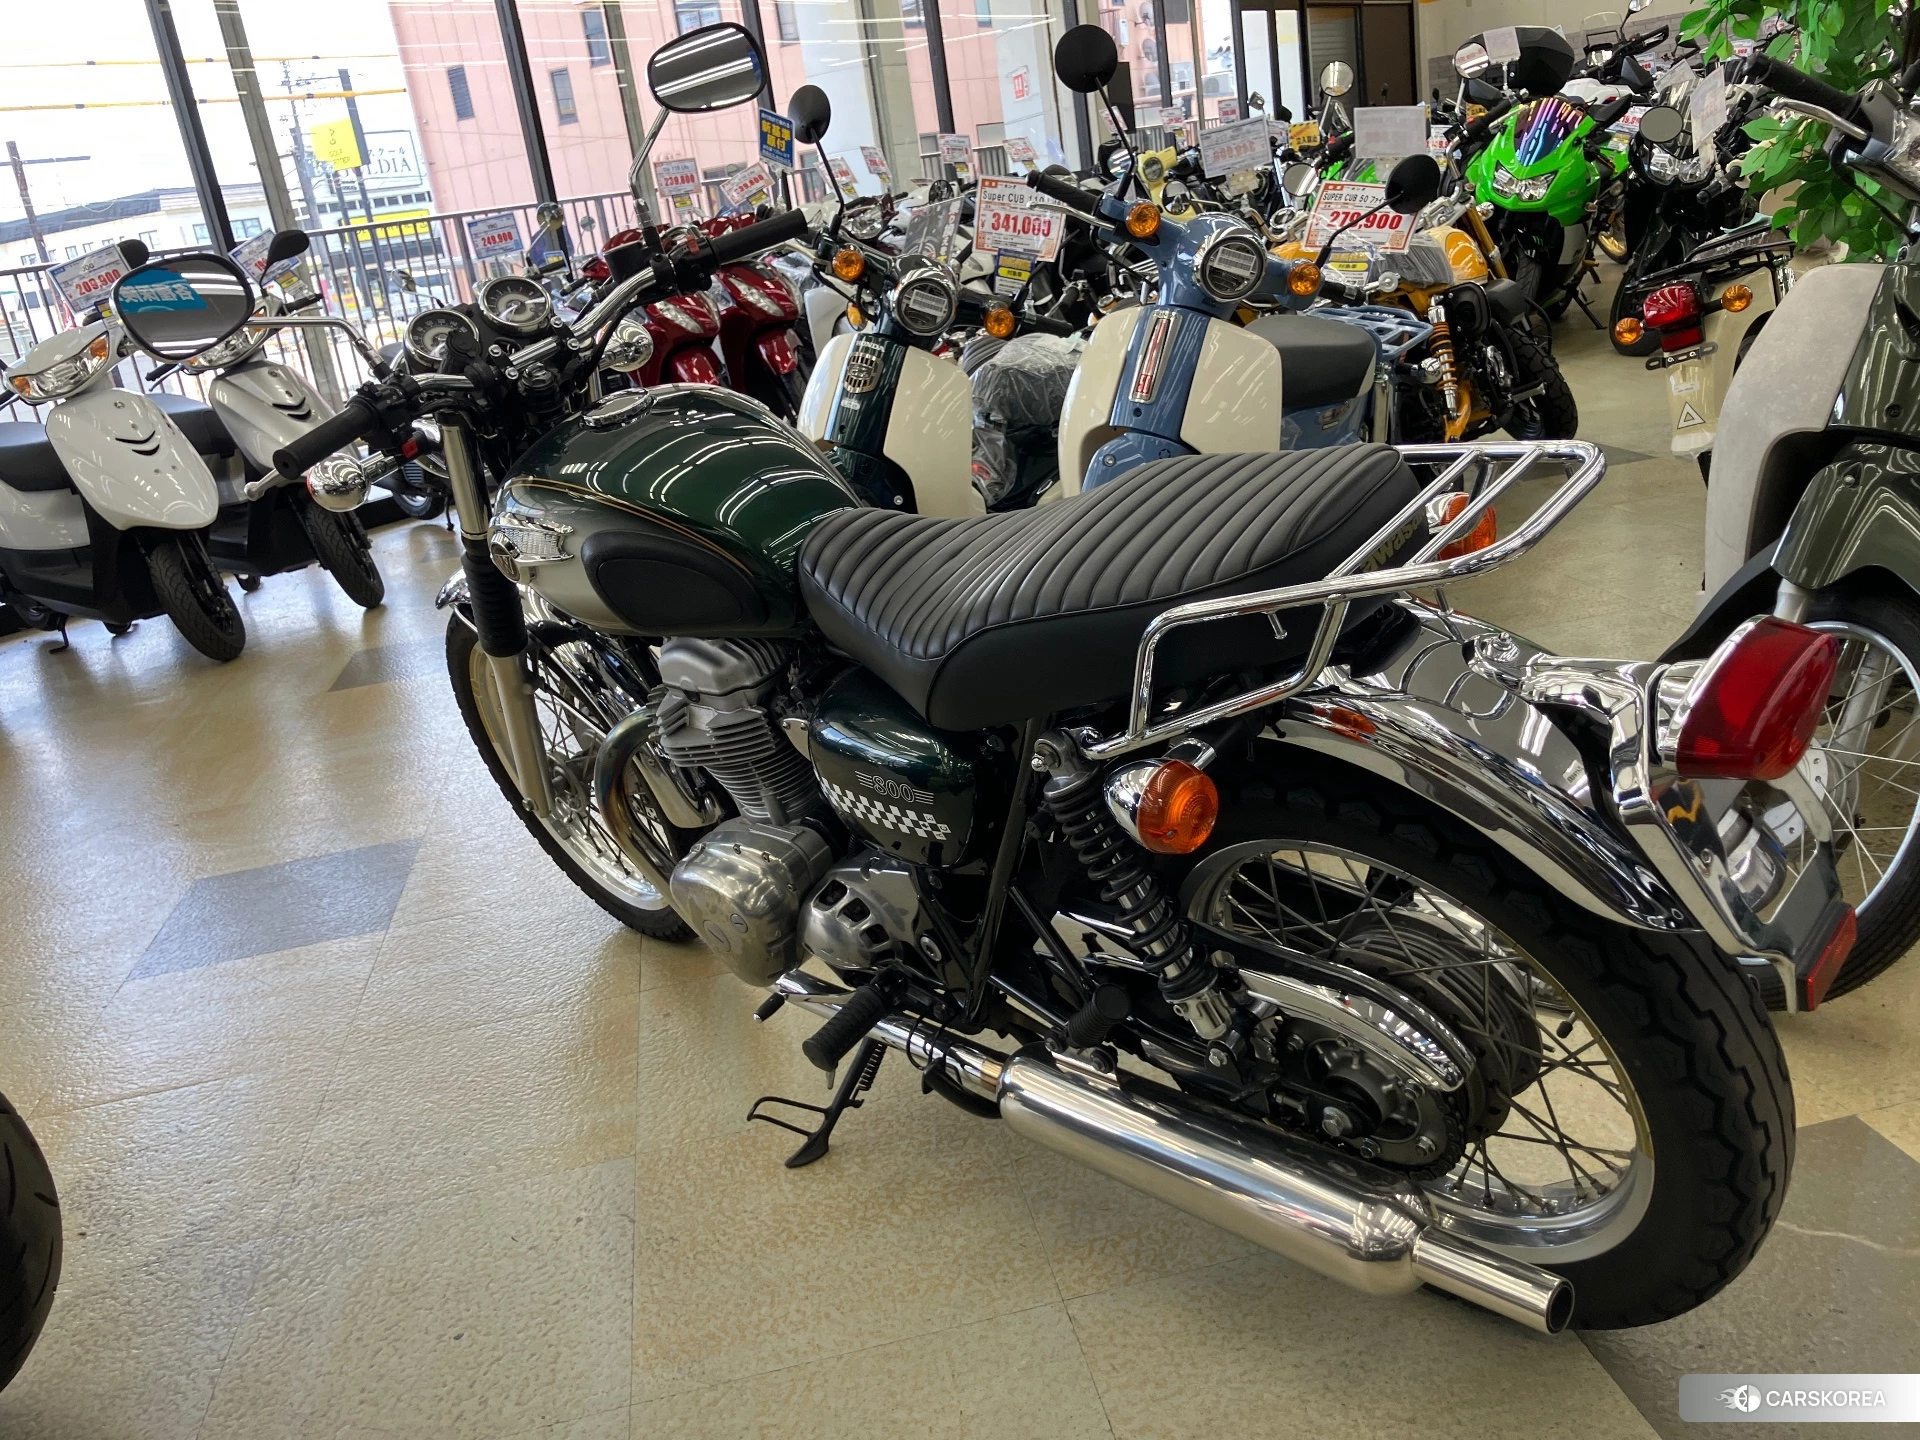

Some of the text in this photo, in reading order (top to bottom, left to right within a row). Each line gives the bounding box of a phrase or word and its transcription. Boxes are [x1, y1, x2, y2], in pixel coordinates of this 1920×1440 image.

[983, 190, 1006, 202] Super
[1008, 193, 1026, 205] CUB
[1323, 192, 1344, 201] SUPER
[1345, 193, 1358, 202] CUB
[1360, 195, 1369, 203] 50
[991, 212, 1052, 238] 341,000
[75, 268, 122, 296] 209,900
[872, 775, 915, 803] 800
